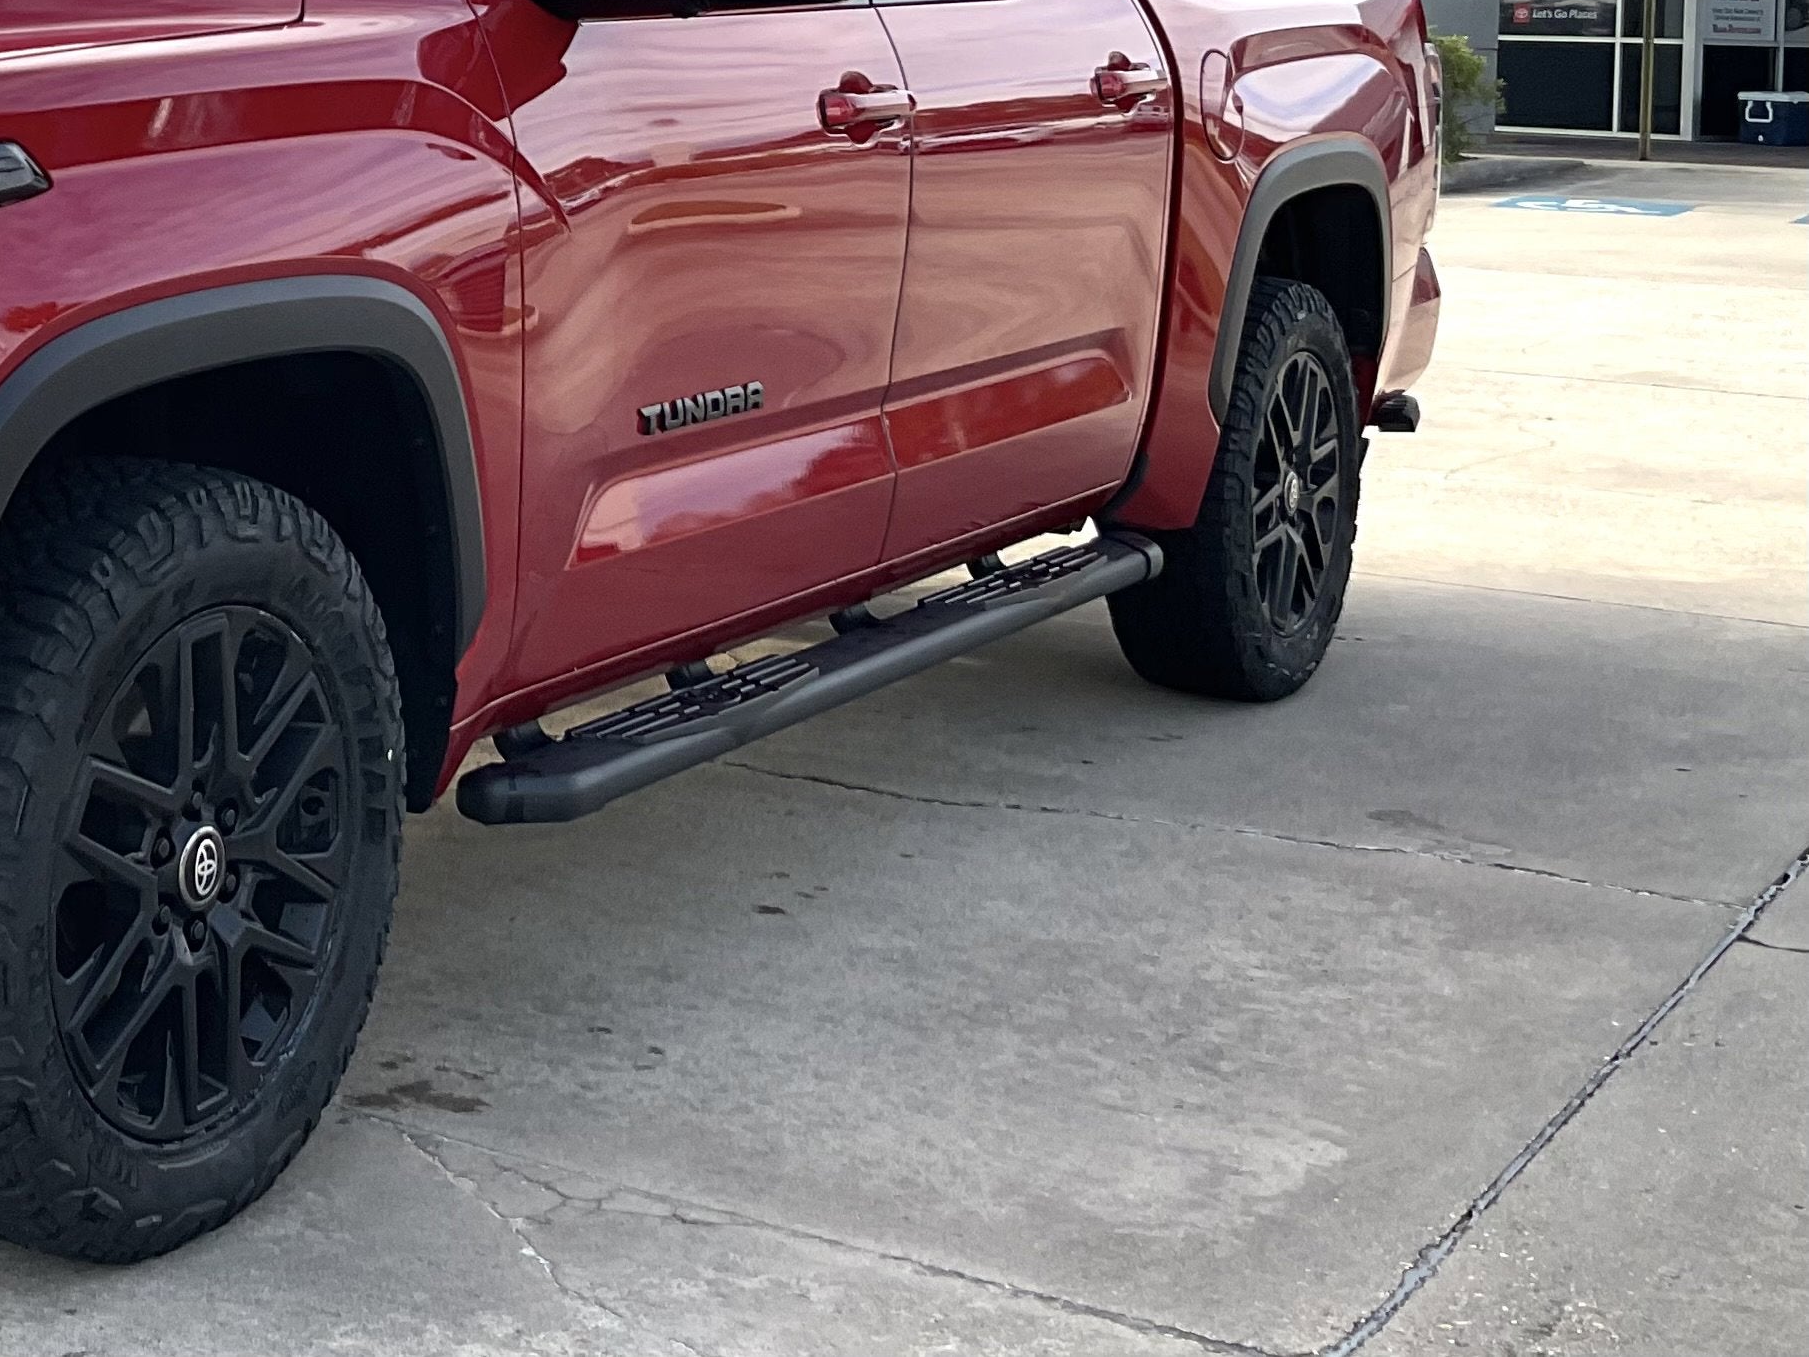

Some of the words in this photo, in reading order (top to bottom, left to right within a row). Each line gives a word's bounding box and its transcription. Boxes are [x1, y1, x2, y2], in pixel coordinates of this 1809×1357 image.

[1532, 8, 1553, 19] Let's
[1554, 9, 1568, 19] Go
[1569, 9, 1598, 20] Places
[637, 379, 764, 436] TUNDRA
